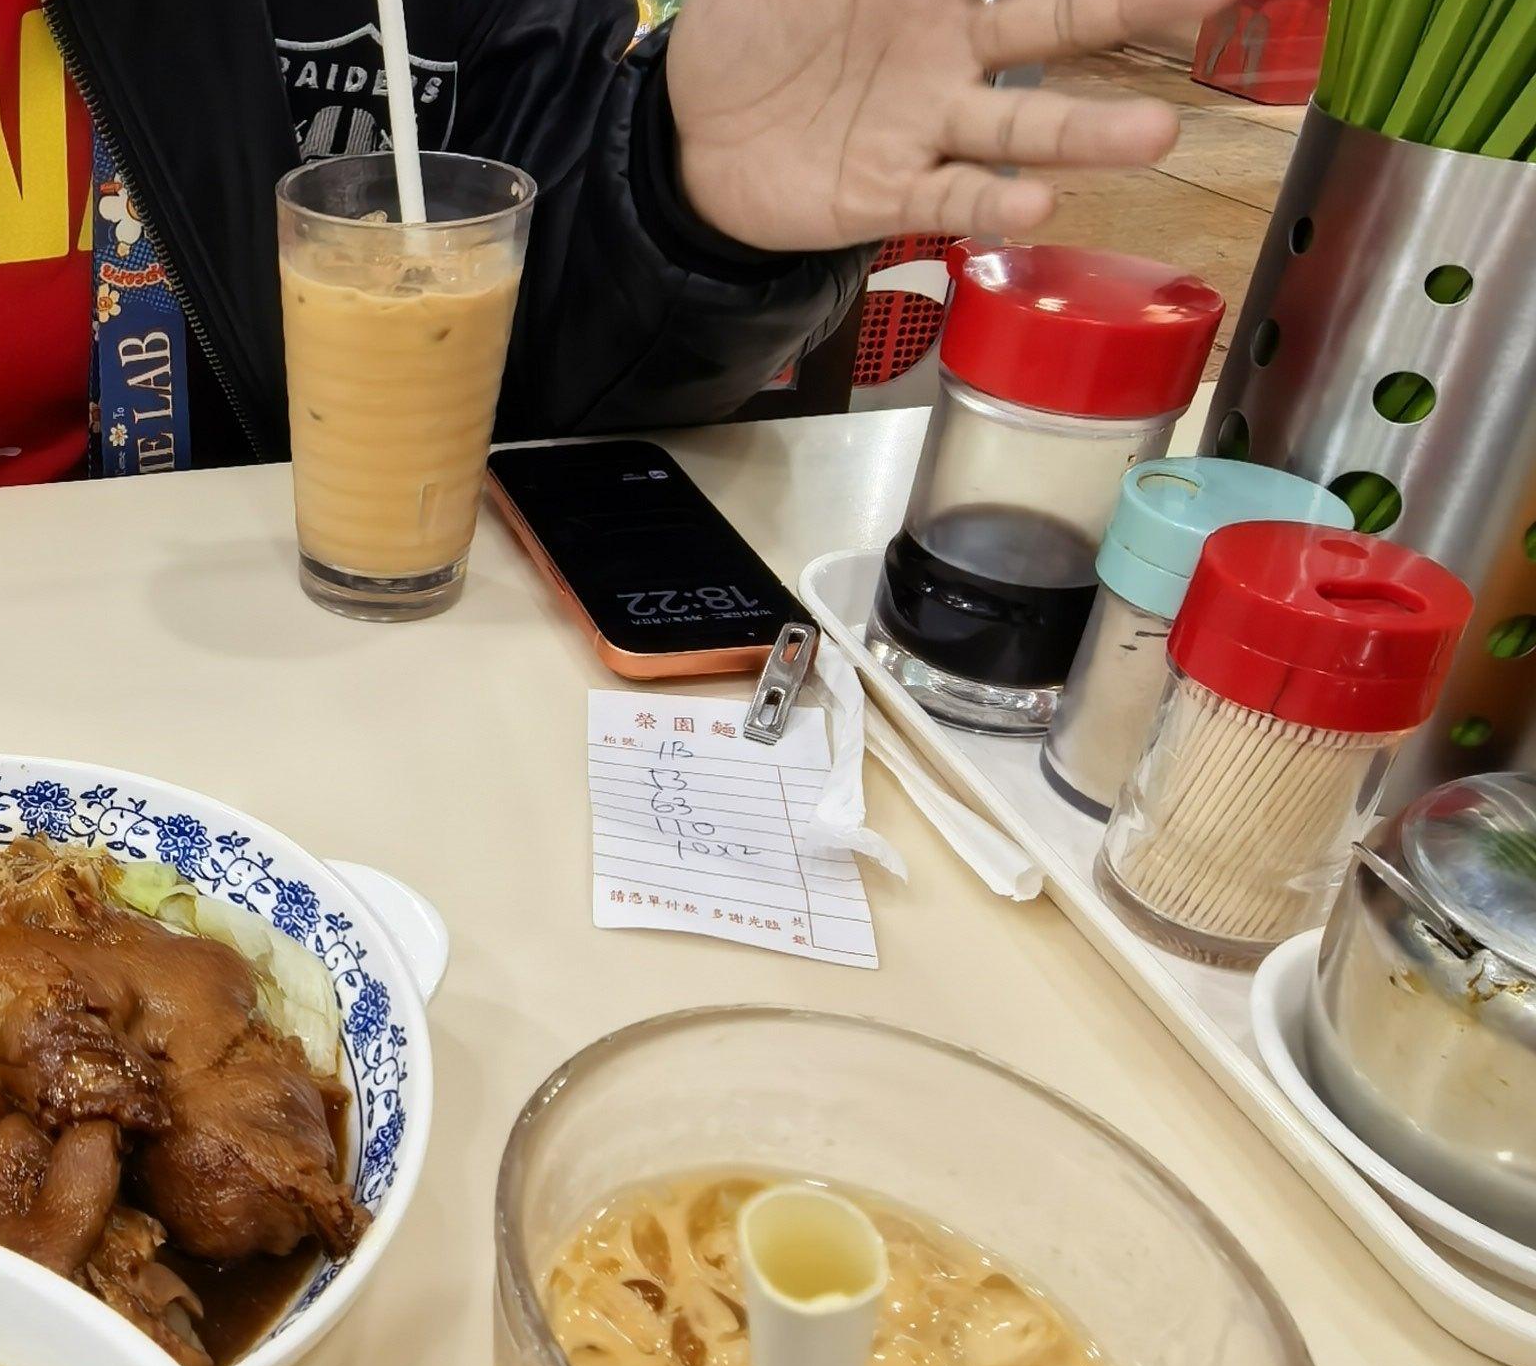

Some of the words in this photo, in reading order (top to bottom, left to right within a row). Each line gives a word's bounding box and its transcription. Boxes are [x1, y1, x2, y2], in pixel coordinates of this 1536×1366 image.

[278, 56, 443, 104] AIDES
[117, 332, 172, 425] LAB
[616, 584, 760, 616] 18:22
[651, 791, 693, 815] 63
